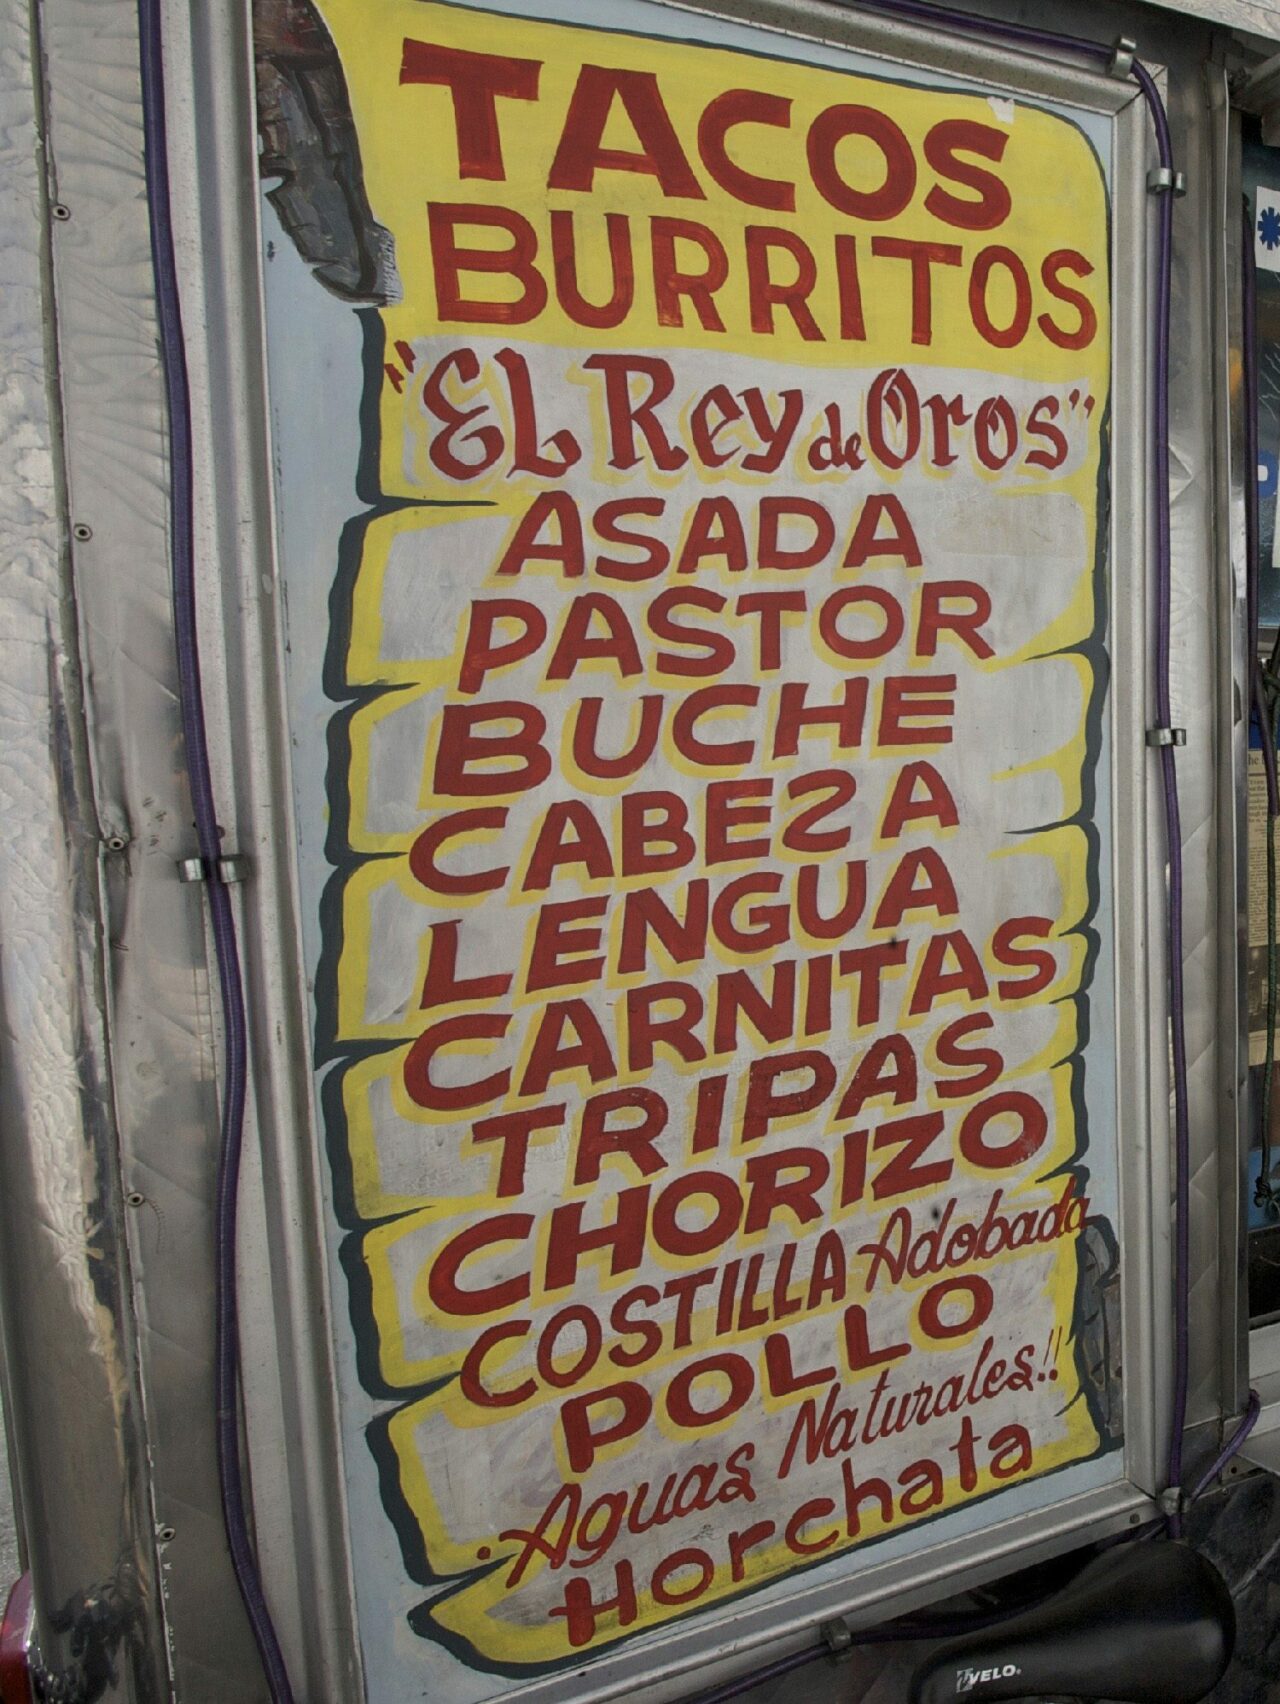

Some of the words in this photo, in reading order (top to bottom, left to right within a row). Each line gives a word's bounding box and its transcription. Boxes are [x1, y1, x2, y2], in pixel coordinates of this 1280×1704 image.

[400, 39, 1011, 231] TACOS
[428, 203, 1097, 350] BURRITOS
[584, 353, 804, 474] Rey
[808, 402, 864, 472] de
[496, 493, 922, 581] ASADA
[459, 581, 996, 694] PASTOR
[433, 674, 957, 796] BUCHE
[419, 848, 959, 1009] LENGUA
[403, 917, 1056, 1110] CARNITAS
[471, 1012, 1003, 1198] TRIPAS
[428, 1092, 1049, 1316] CHORIZO
[459, 1227, 846, 1408] COSTILLA
[856, 1175, 1091, 1288] Adobada
[561, 1275, 994, 1474] POLLO
[498, 1443, 754, 1588] Aguas
[547, 1415, 1034, 1648] Horchata
[968, 1664, 1017, 1686] VELO
